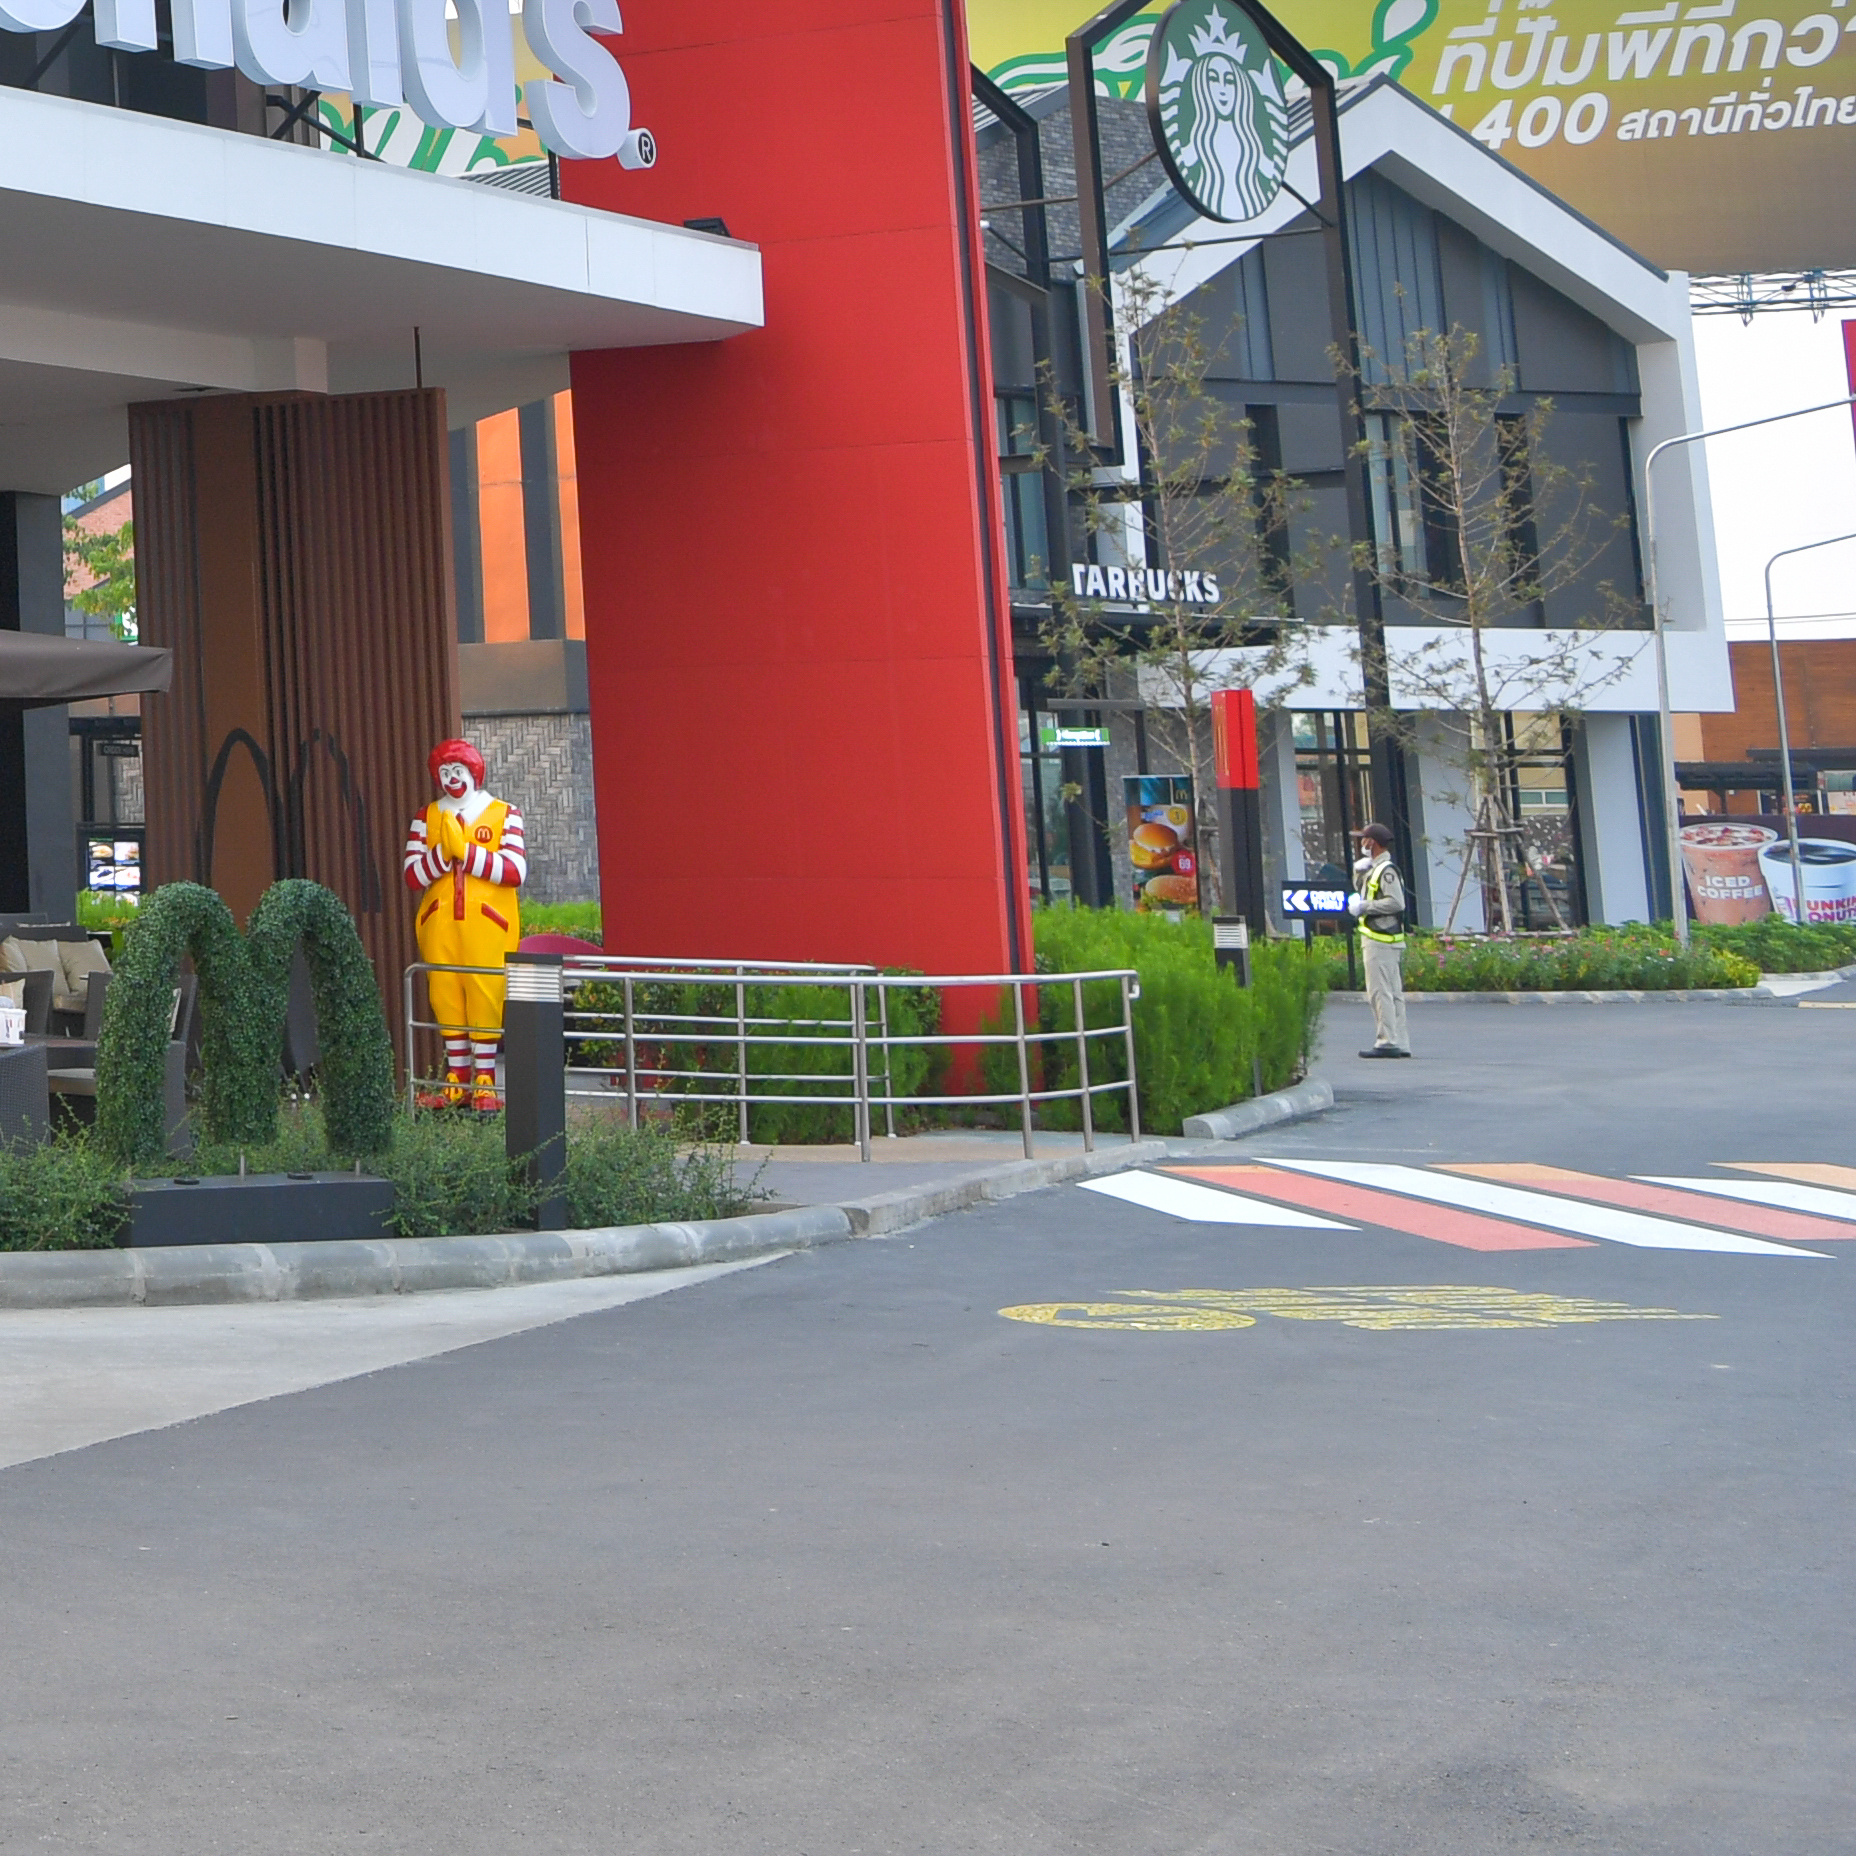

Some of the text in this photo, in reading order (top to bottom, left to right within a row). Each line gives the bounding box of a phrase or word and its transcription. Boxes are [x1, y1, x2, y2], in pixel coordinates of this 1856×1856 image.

[1439, 92, 1610, 150] 400
[1071, 563, 1220, 603] TARBUCKS
[1705, 875, 1751, 888] ICED
[1697, 884, 1763, 900] COFFEE
[1806, 896, 1856, 911] UNKI
[1808, 908, 1856, 922] ONUT
